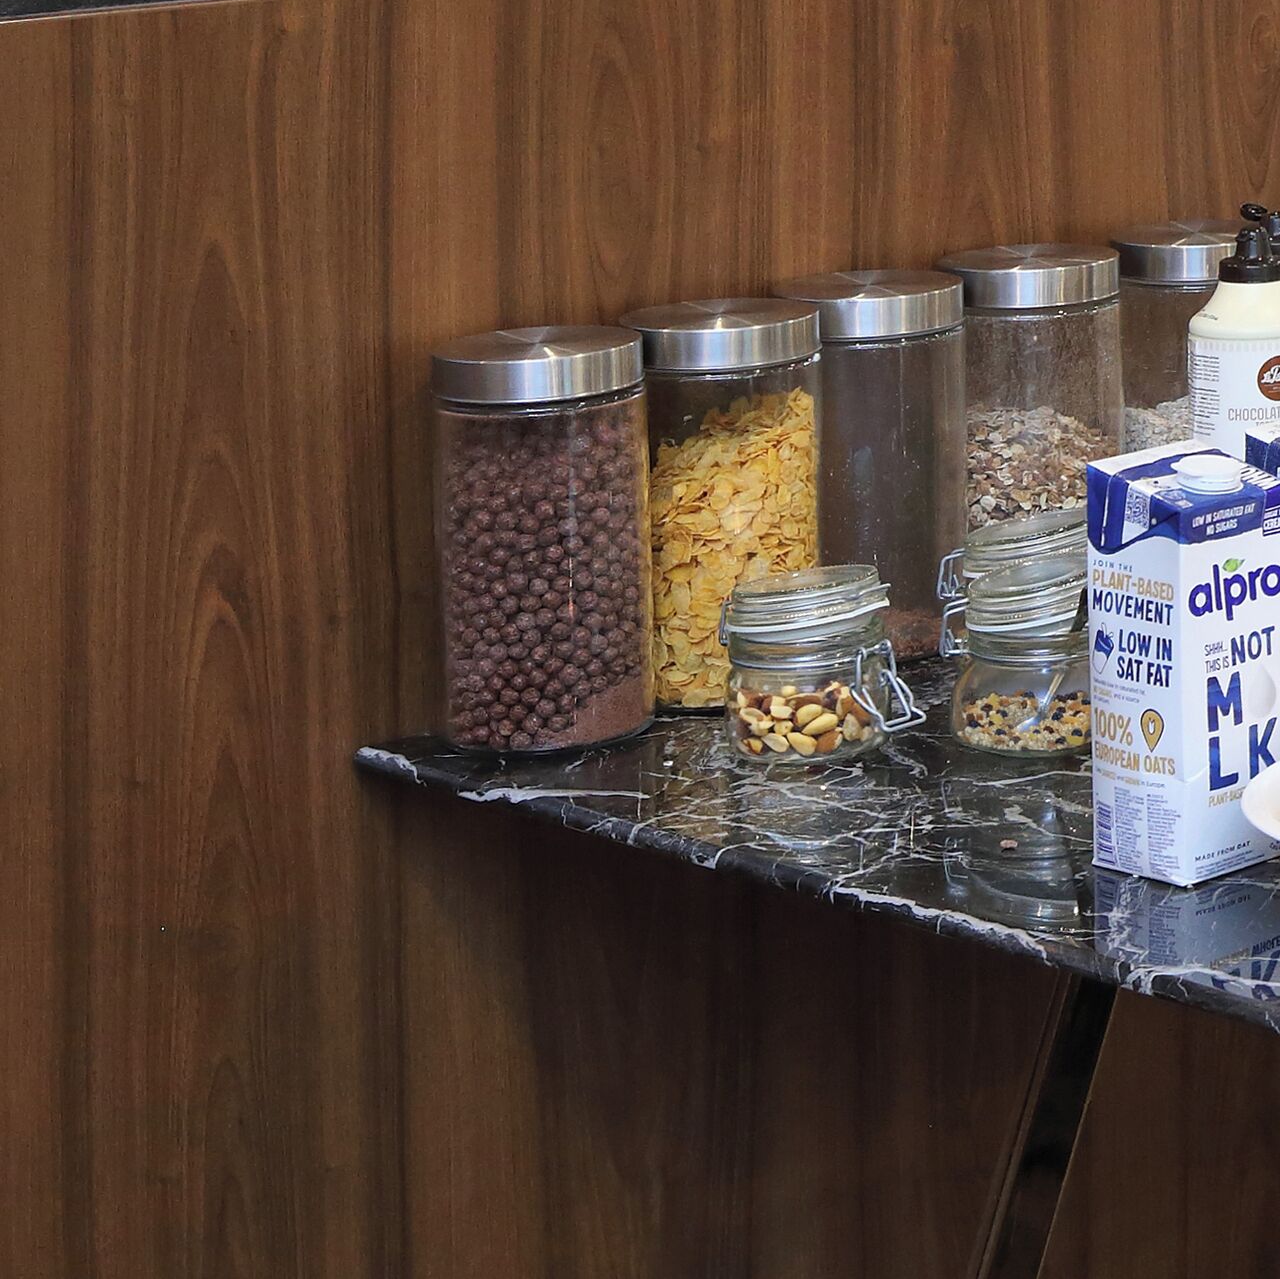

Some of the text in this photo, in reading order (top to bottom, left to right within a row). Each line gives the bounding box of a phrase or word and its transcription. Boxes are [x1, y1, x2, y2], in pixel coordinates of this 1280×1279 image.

[1215, 519, 1238, 534] SUGARS
[1093, 560, 1133, 573] JOIN THE
[1092, 569, 1174, 602] PLANT-BASED
[1092, 588, 1174, 626] MOVEMENT
[1118, 628, 1172, 662] LOW IN
[1205, 625, 1275, 674] THIS IS NOT
[1116, 655, 1173, 688] SAT FAT
[1094, 707, 1133, 747] 100%
[1094, 740, 1176, 776] EUROPEAN OATS
[1195, 840, 1251, 861] MADE FROM OAT
